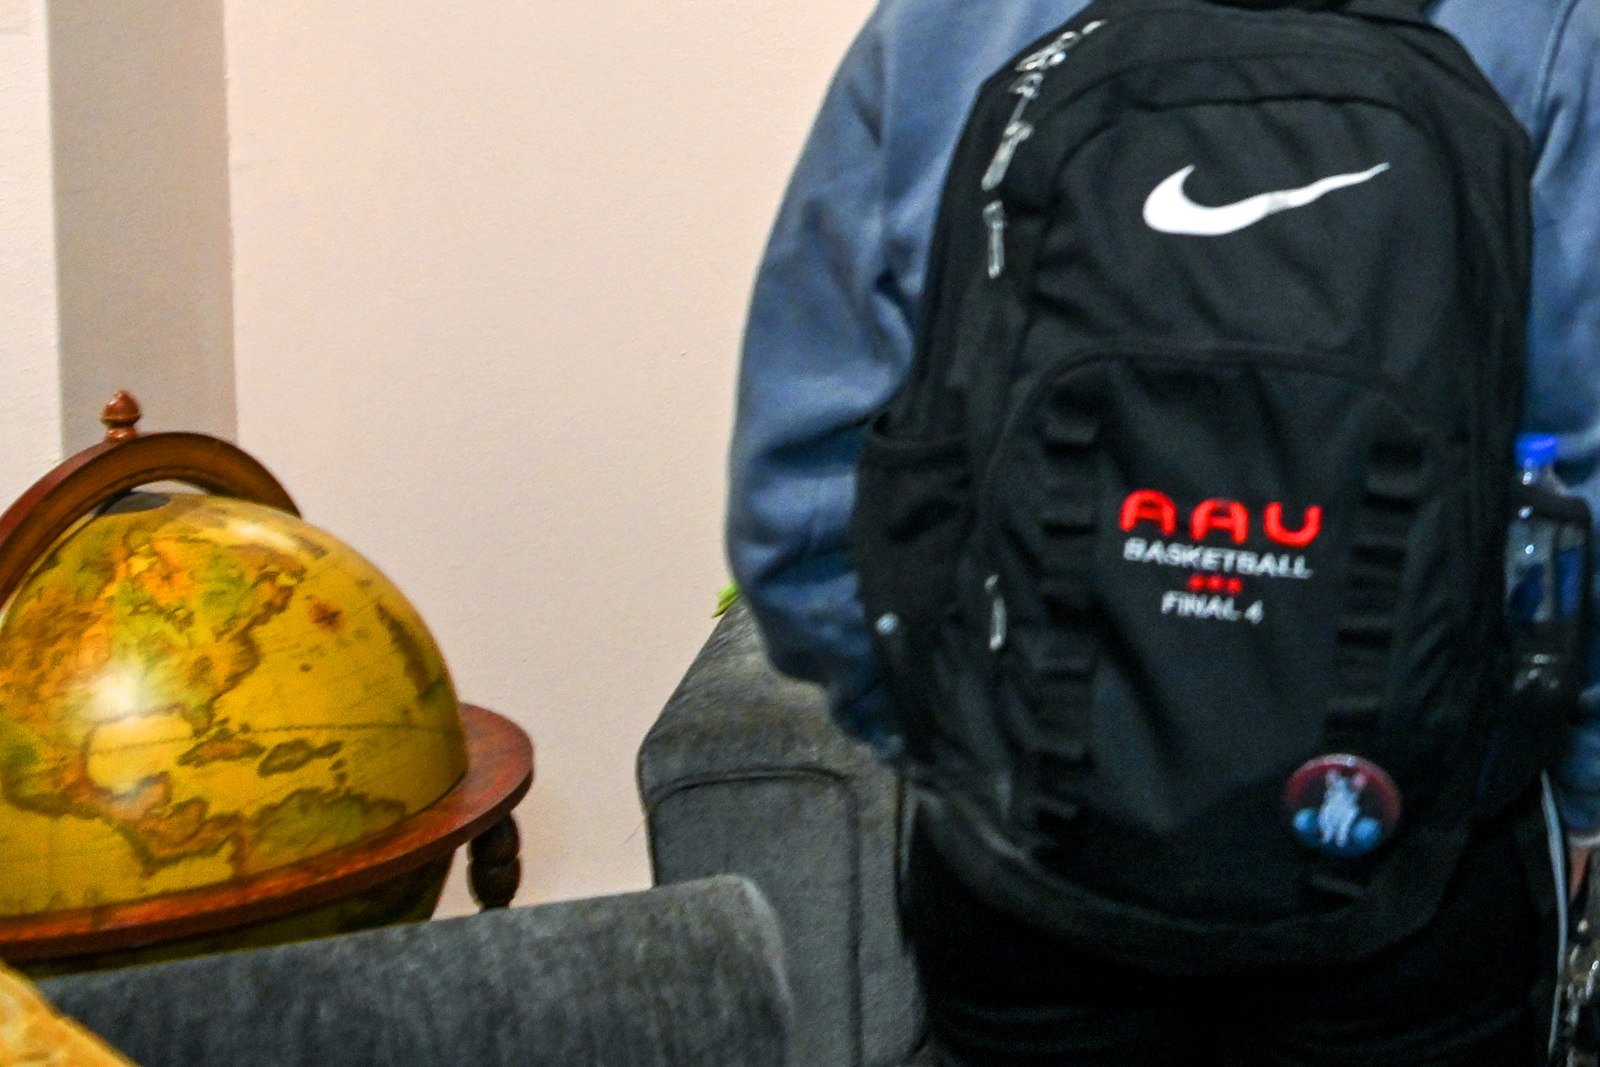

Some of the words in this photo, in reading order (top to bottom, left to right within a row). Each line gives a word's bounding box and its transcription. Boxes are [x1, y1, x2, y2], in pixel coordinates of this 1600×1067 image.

[1120, 488, 1323, 549] AAU
[1123, 536, 1315, 580] BASKETBALL
[1160, 589, 1242, 622] FINAL
[1244, 598, 1264, 625] 4
